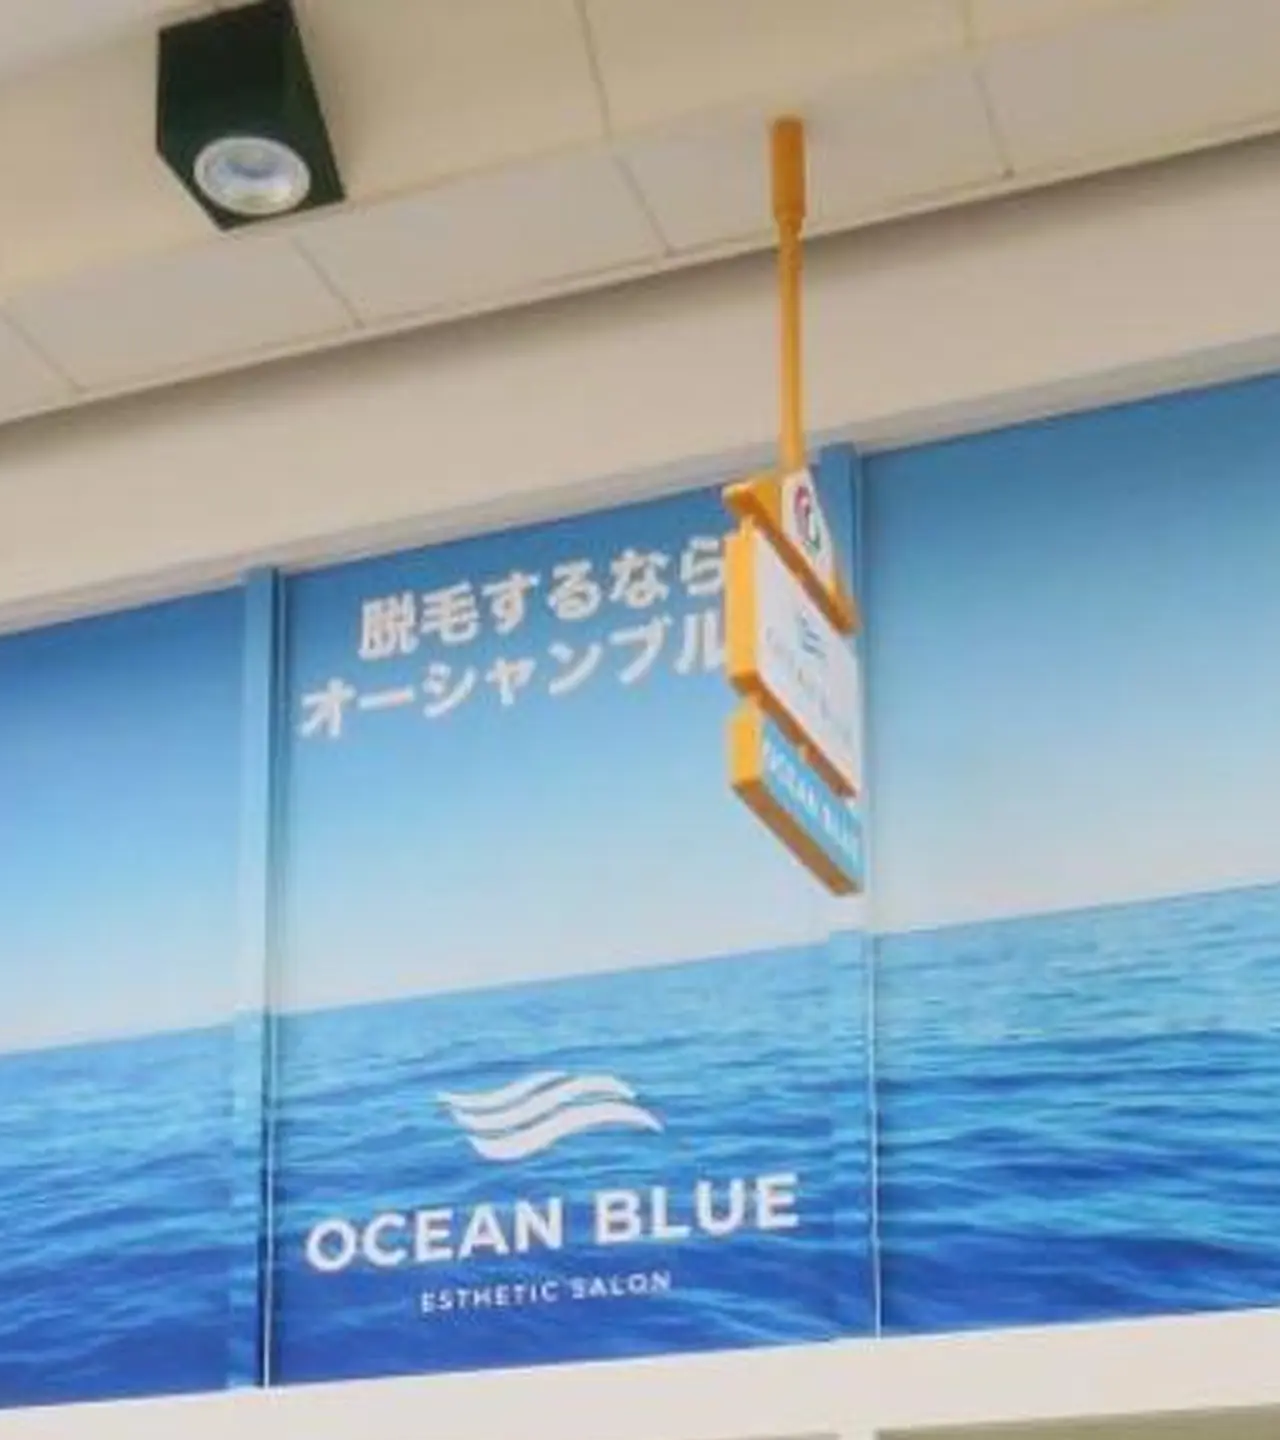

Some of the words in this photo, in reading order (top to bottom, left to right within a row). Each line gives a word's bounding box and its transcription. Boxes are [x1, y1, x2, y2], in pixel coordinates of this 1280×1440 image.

[357, 536, 726, 661] 脱毛するなら
[305, 1195, 564, 1273] OCEAN
[595, 1172, 800, 1246] BLUE
[421, 1280, 559, 1313] ESTHETIC
[569, 1270, 672, 1302] SALON
